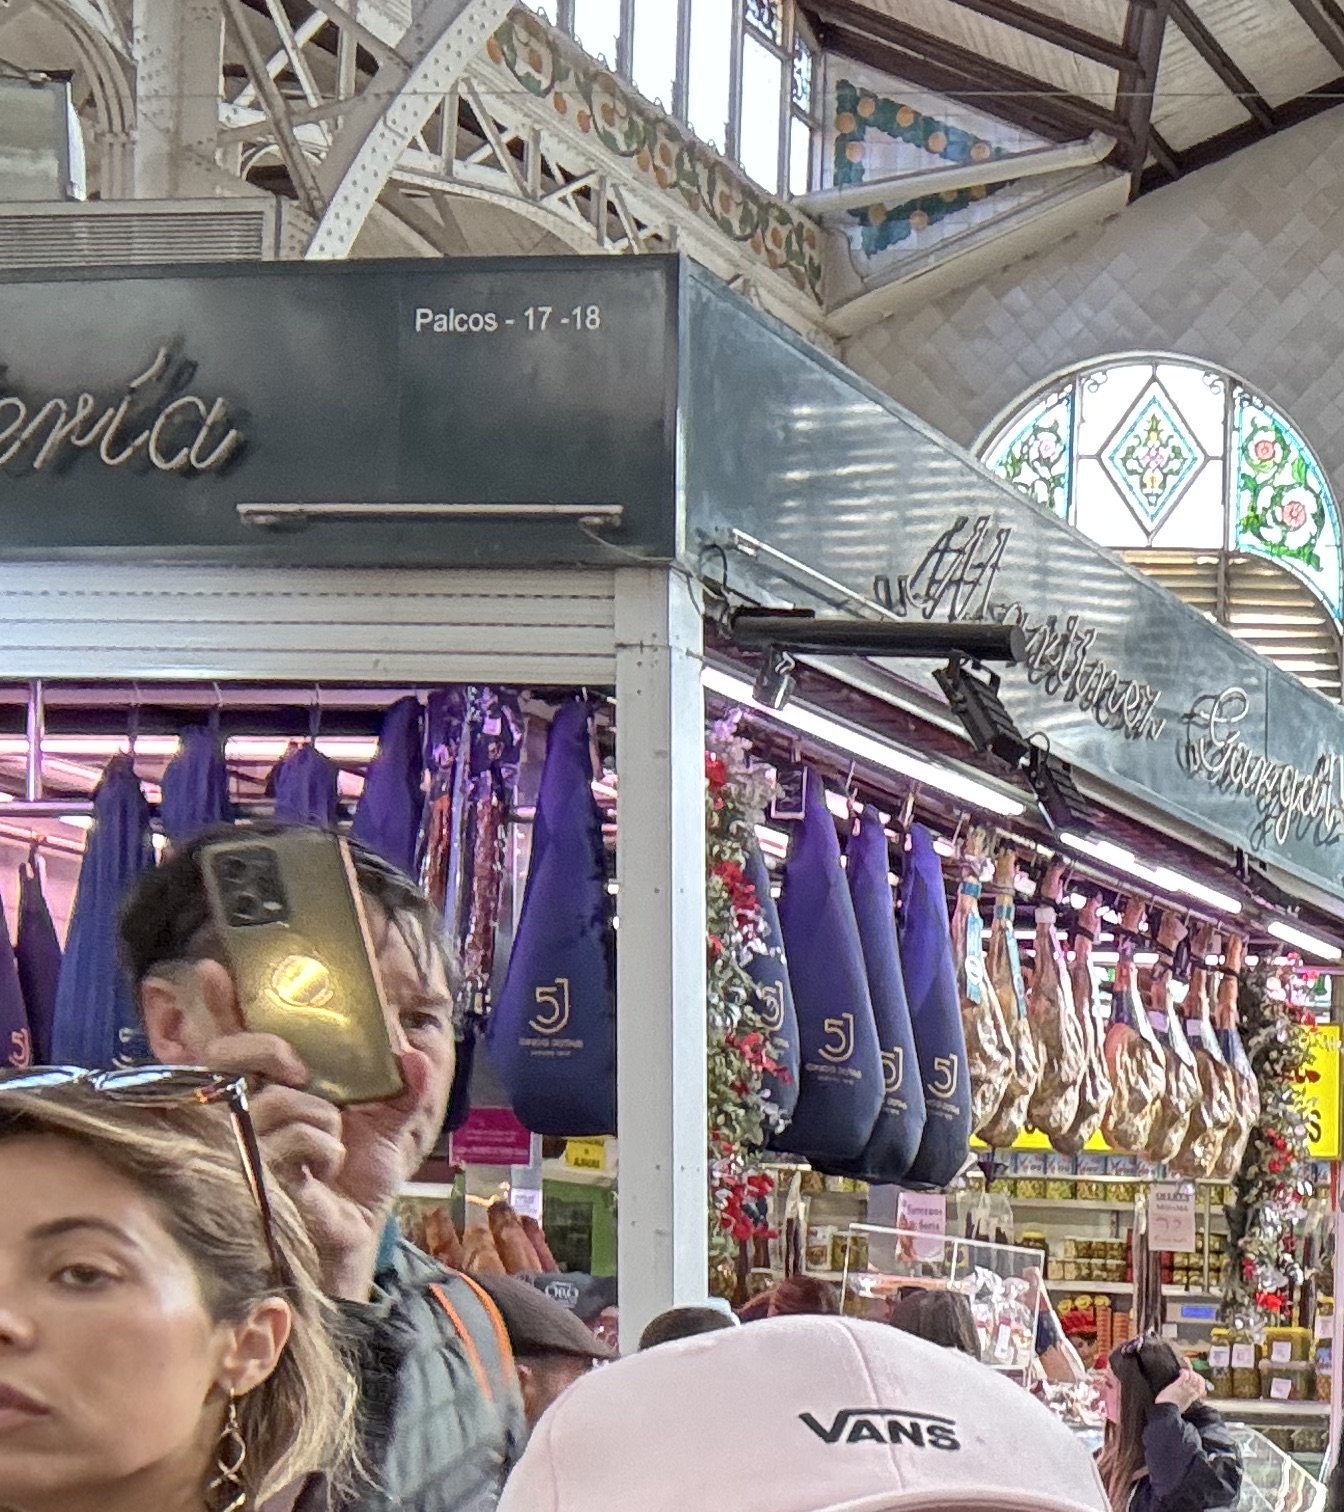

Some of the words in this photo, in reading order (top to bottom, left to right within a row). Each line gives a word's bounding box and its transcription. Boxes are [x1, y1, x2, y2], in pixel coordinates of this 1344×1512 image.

[415, 307, 498, 332] Palcos
[524, 306, 552, 331] 17
[528, 977, 569, 1035] 5J
[818, 1012, 855, 1062] 5J
[927, 1053, 958, 1099] 5J
[799, 1408, 960, 1451] VANS
